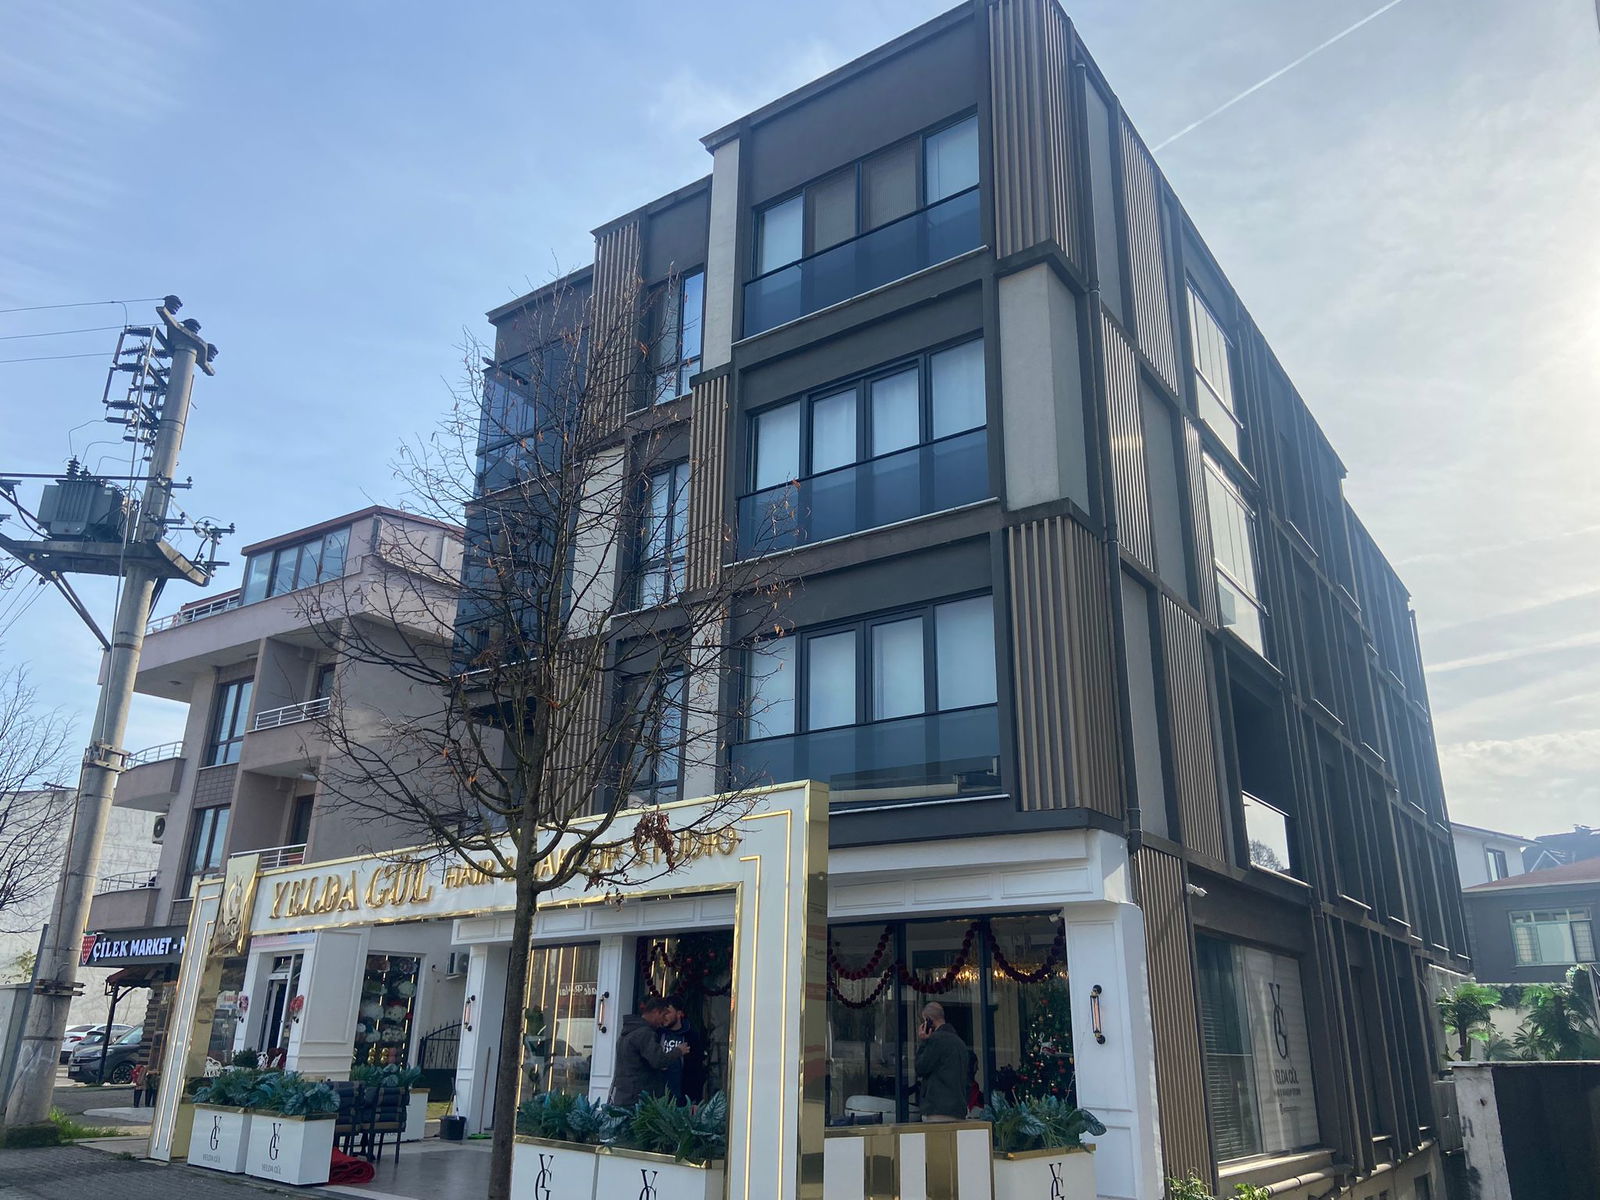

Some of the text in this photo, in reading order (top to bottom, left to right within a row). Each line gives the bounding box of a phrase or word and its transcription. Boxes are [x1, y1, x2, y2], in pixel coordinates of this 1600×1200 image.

[269, 869, 359, 919] YELDA
[445, 860, 495, 889] HAIR
[92, 938, 129, 961] ÇİLEK
[129, 937, 172, 957] MARKET
